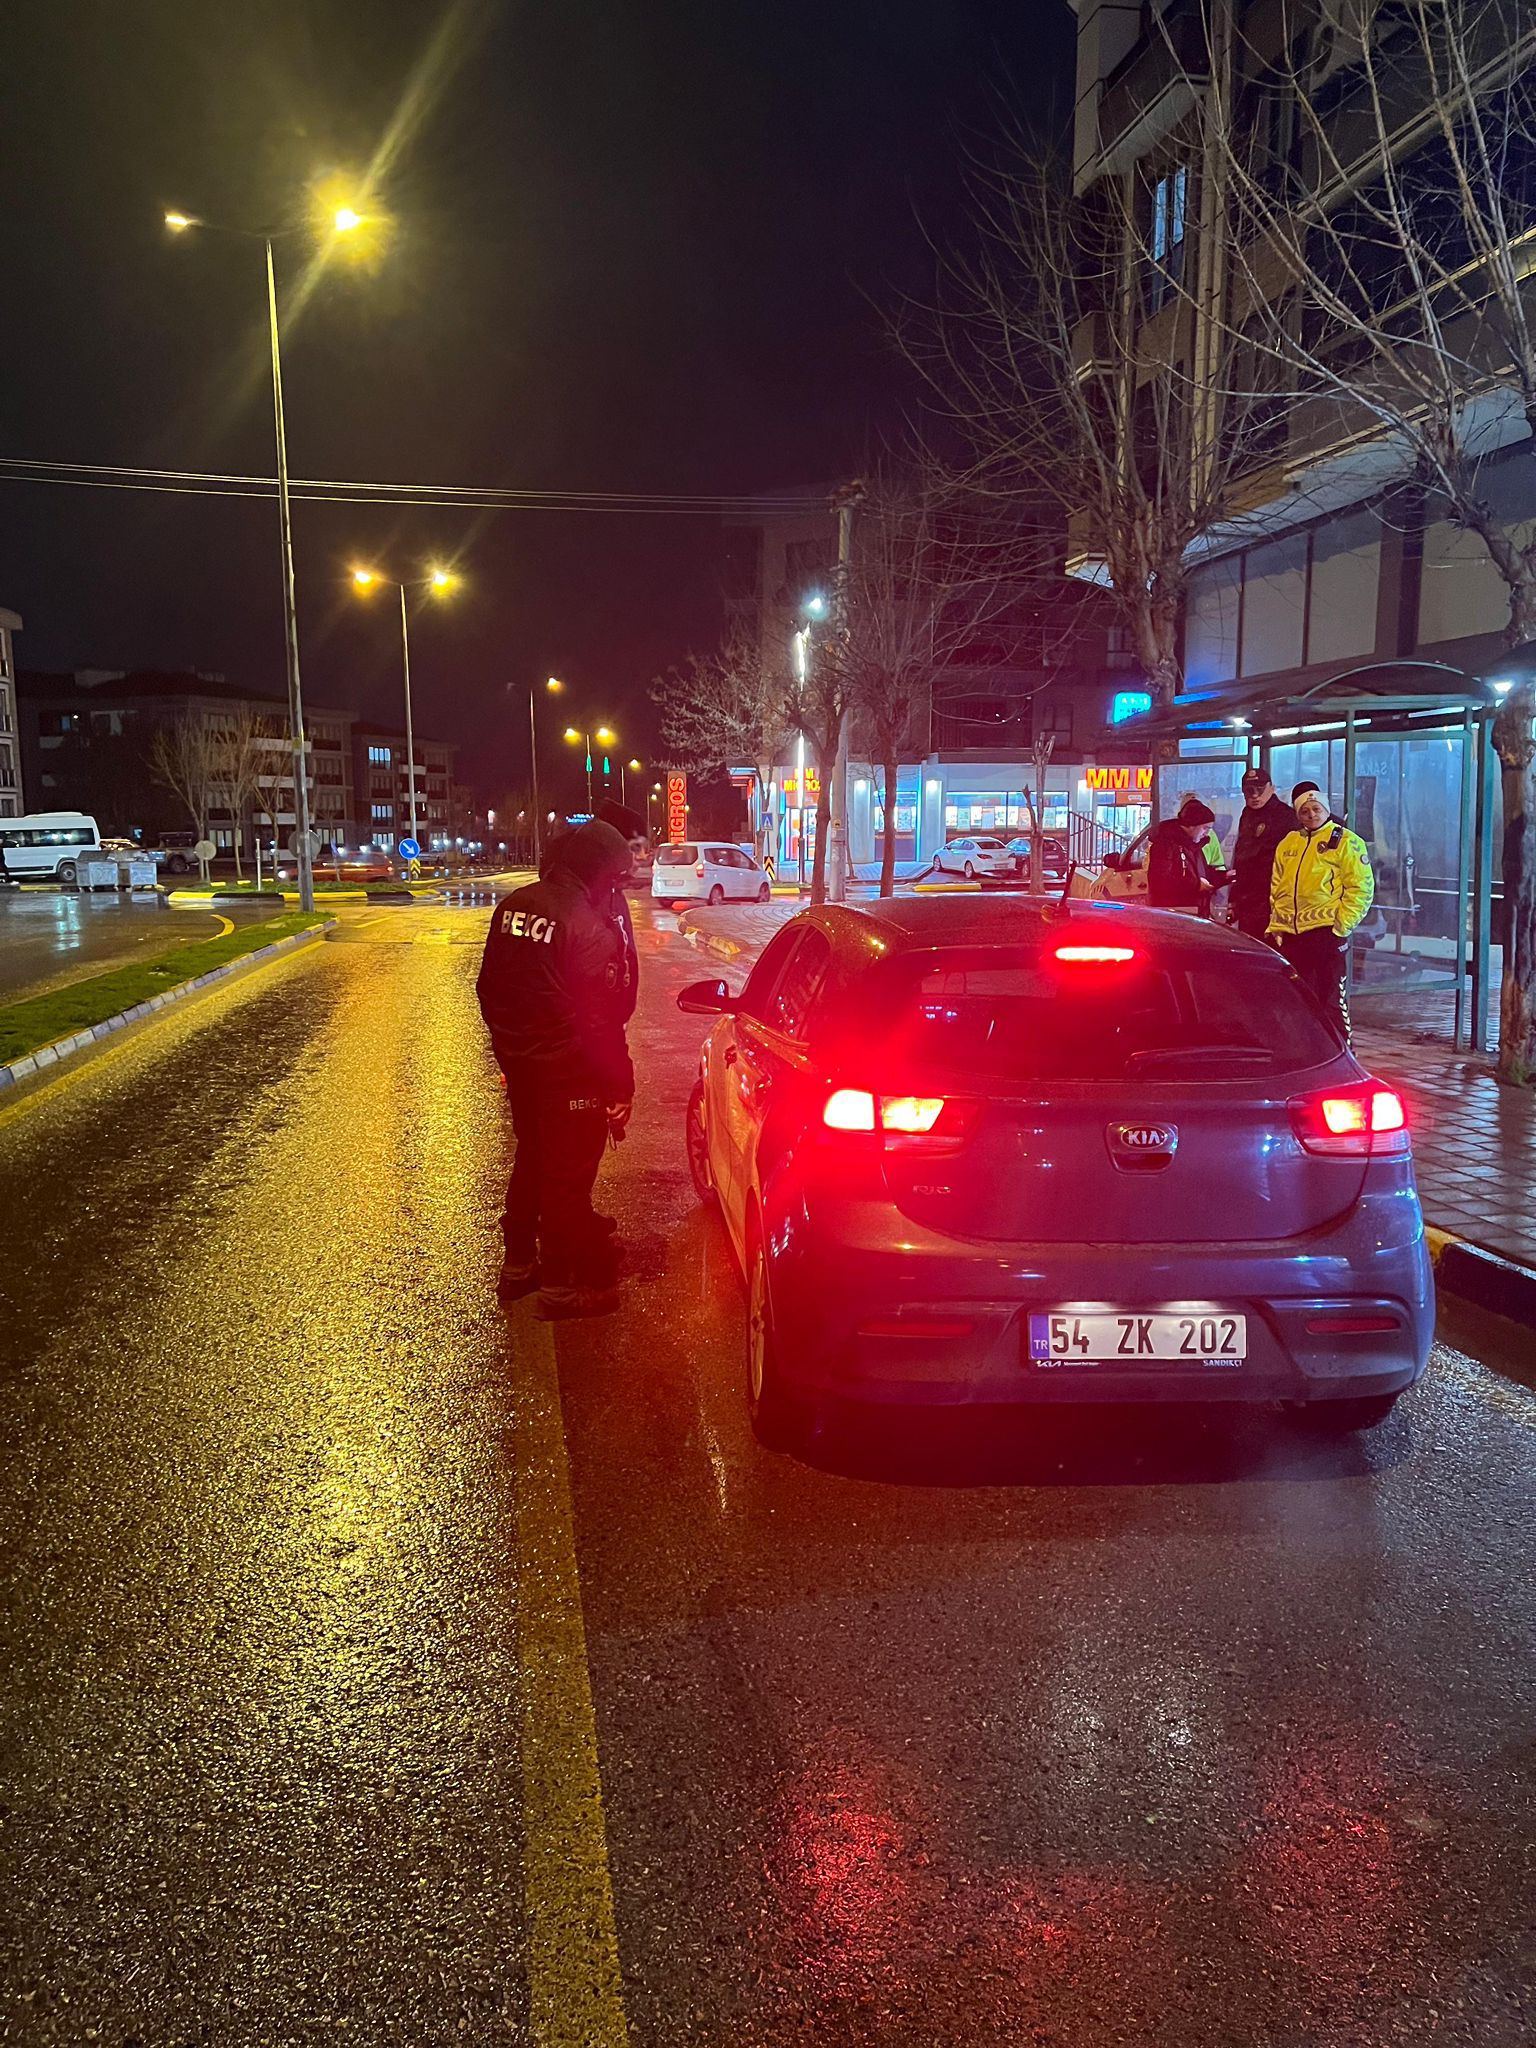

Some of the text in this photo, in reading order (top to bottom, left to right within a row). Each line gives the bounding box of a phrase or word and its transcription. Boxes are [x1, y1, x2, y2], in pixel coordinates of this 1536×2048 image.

[1086, 768, 1130, 789] MM
[1127, 1130, 1160, 1145] KIA
[1033, 1339, 1048, 1351] TR
[1051, 1318, 1237, 1354] 54 ZK 202
